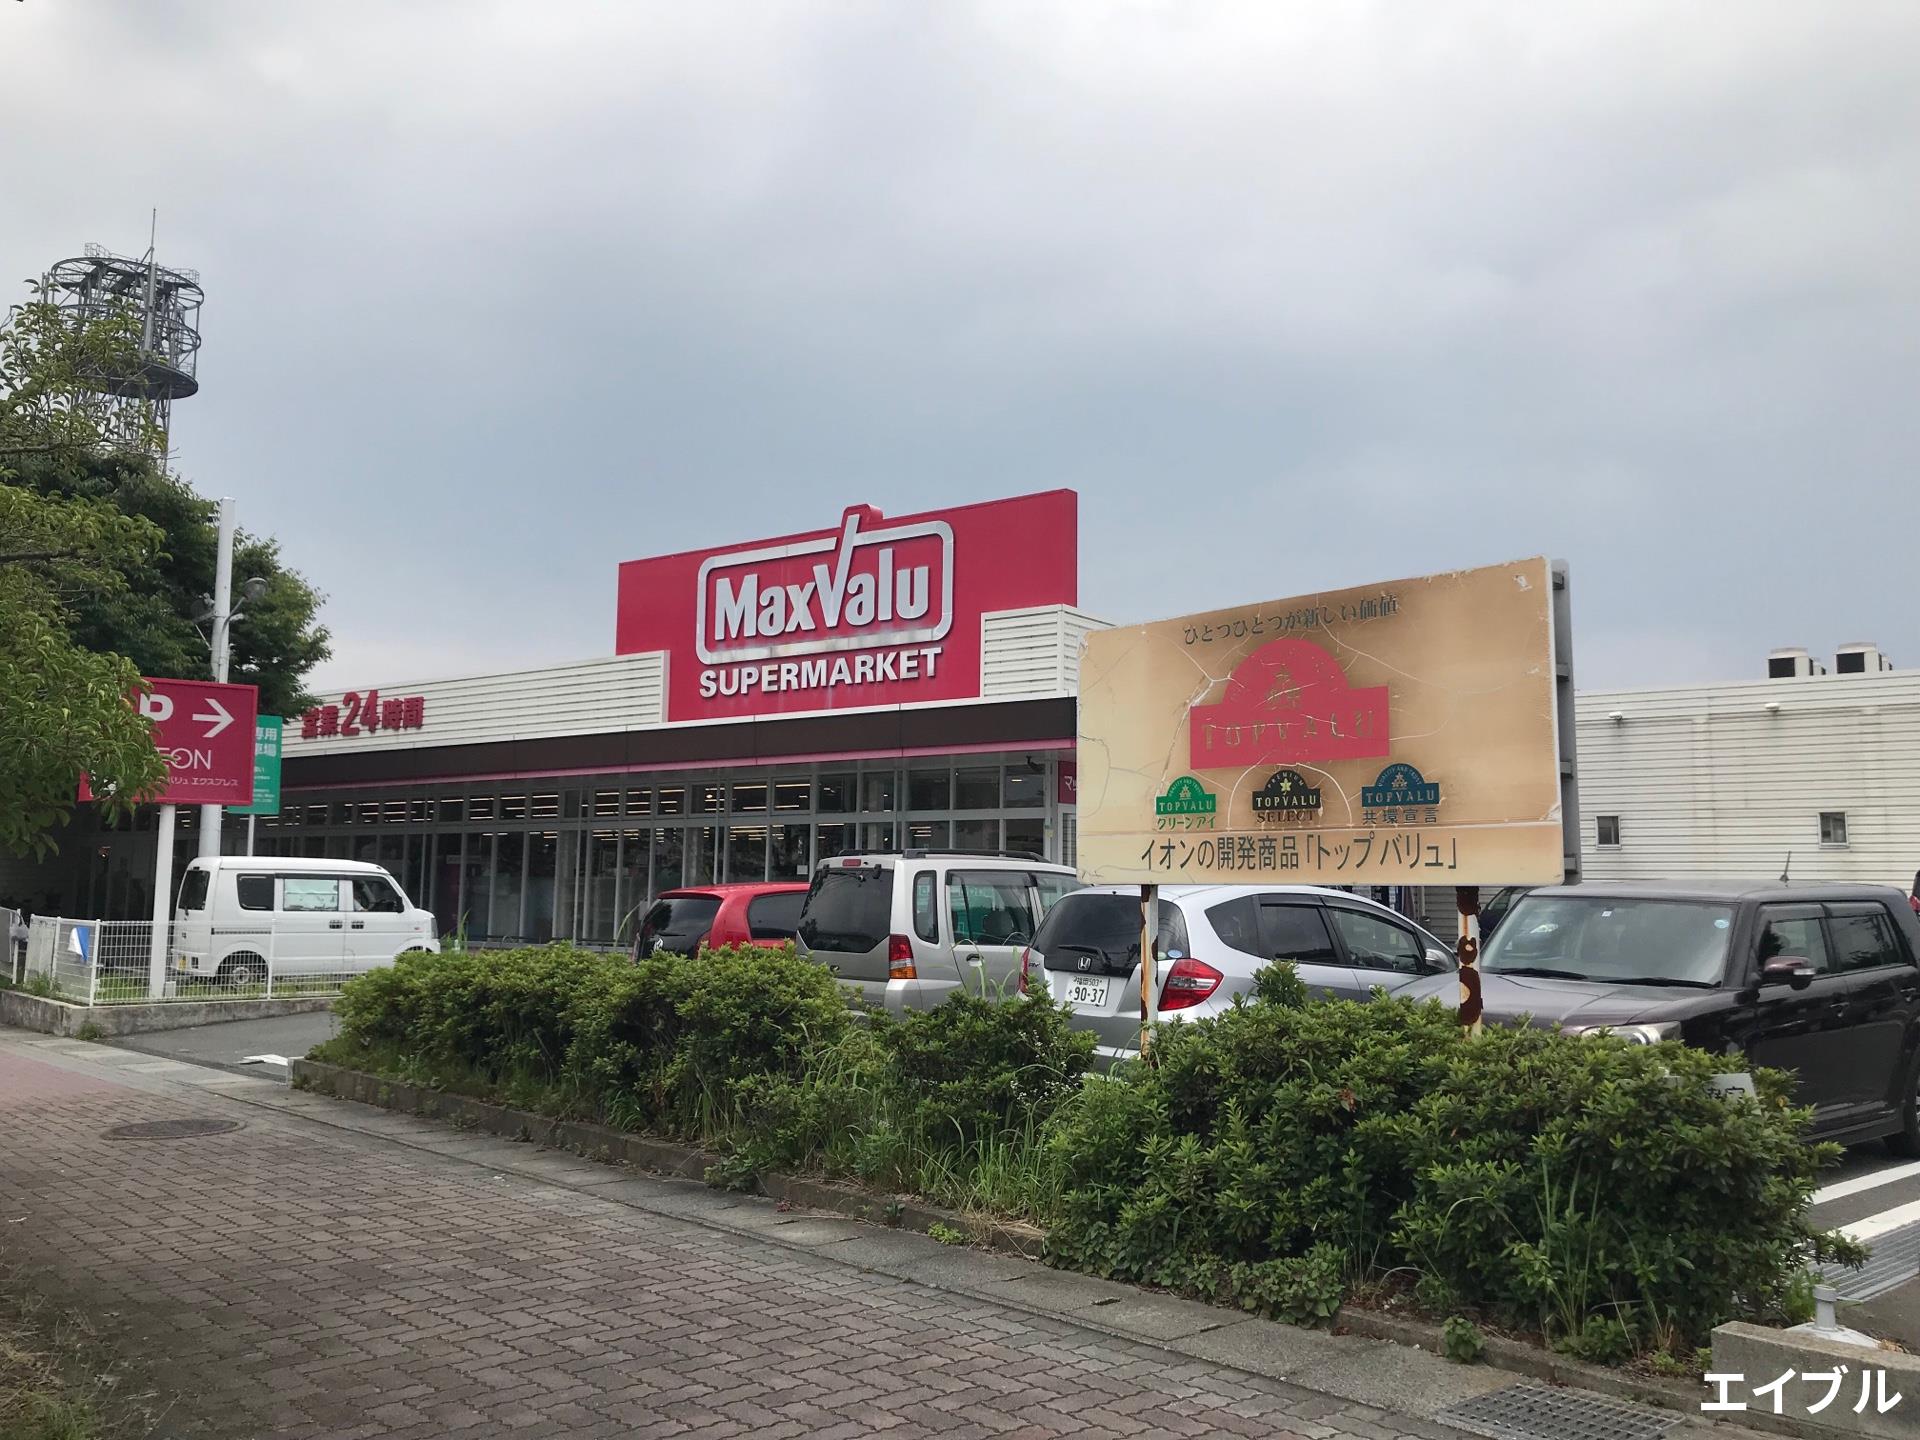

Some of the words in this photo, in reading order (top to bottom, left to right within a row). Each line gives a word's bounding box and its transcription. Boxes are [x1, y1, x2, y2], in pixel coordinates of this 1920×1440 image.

[715, 514, 930, 641] MaxValu
[1184, 594, 1399, 645] ひとつひとつが新しい価値
[699, 647, 942, 698] SUPERMARKET
[139, 693, 174, 722] P
[301, 689, 425, 739] 営業24時間
[1159, 800, 1213, 812] TOPVALU
[1256, 794, 1316, 807] TOPVALU
[1366, 789, 1435, 804] TOPVALU
[1157, 815, 1216, 831] グリーンアイ
[1256, 810, 1314, 824] SELECT
[1362, 807, 1440, 825] 共環宣言
[1141, 831, 1457, 871] イオンの開発商品「トップバリュ」
